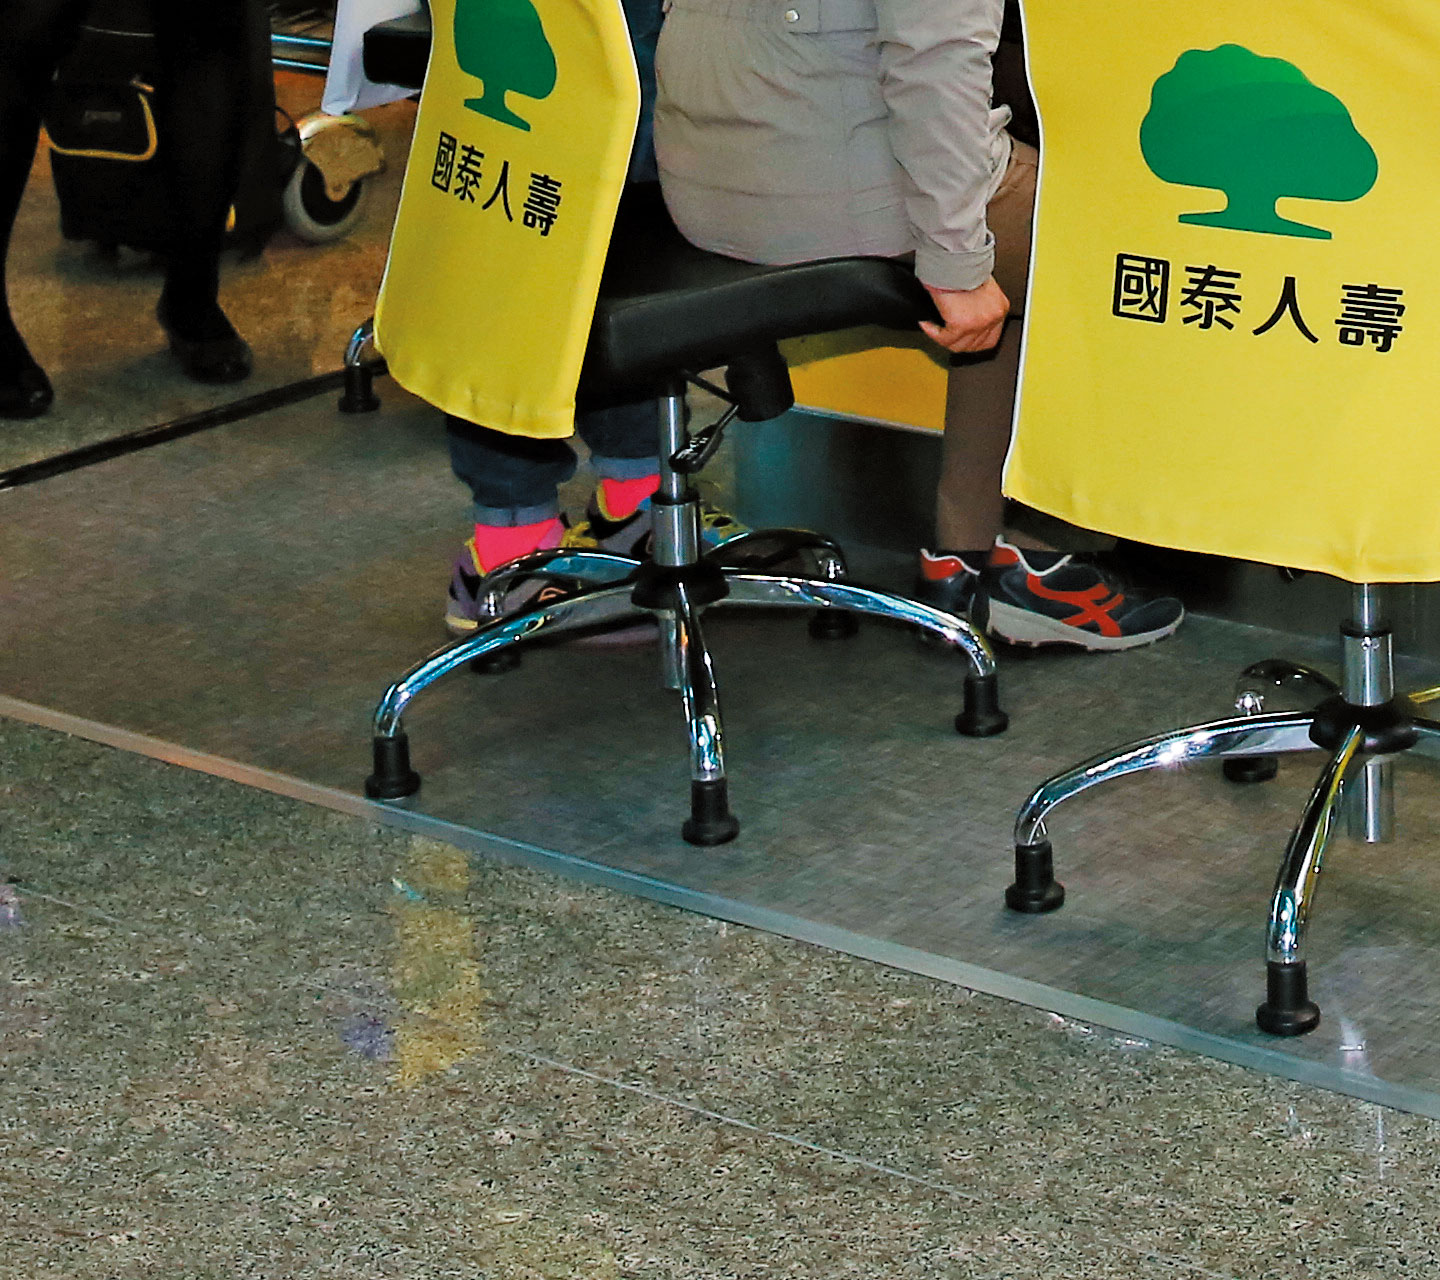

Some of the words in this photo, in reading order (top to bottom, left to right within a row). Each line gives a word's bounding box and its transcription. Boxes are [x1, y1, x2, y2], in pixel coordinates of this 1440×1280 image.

[431, 131, 563, 237] 國泰人壽
[1112, 252, 1406, 353] 國泰人壽
